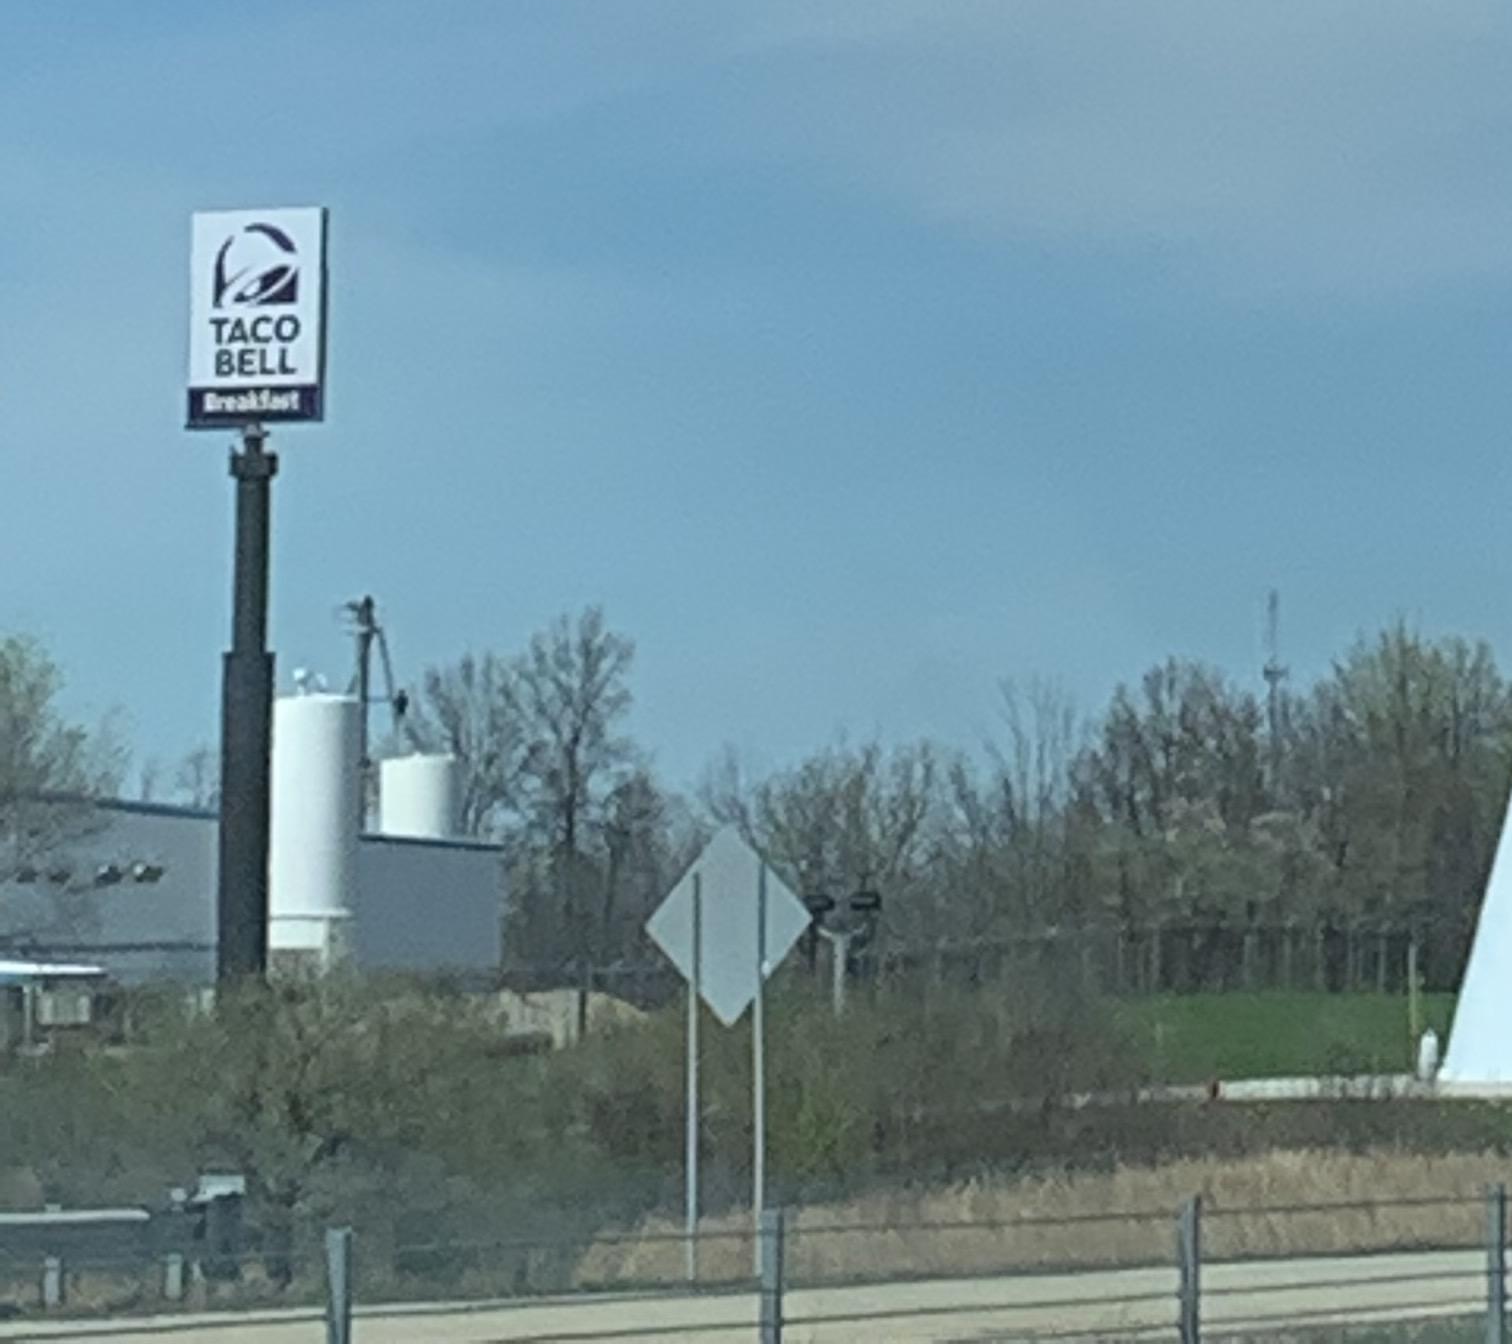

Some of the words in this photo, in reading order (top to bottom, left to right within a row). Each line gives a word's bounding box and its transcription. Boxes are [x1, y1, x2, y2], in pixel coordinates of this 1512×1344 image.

[209, 314, 301, 344] TACO
[215, 347, 297, 377] BELL
[204, 390, 300, 412] Breakfast
